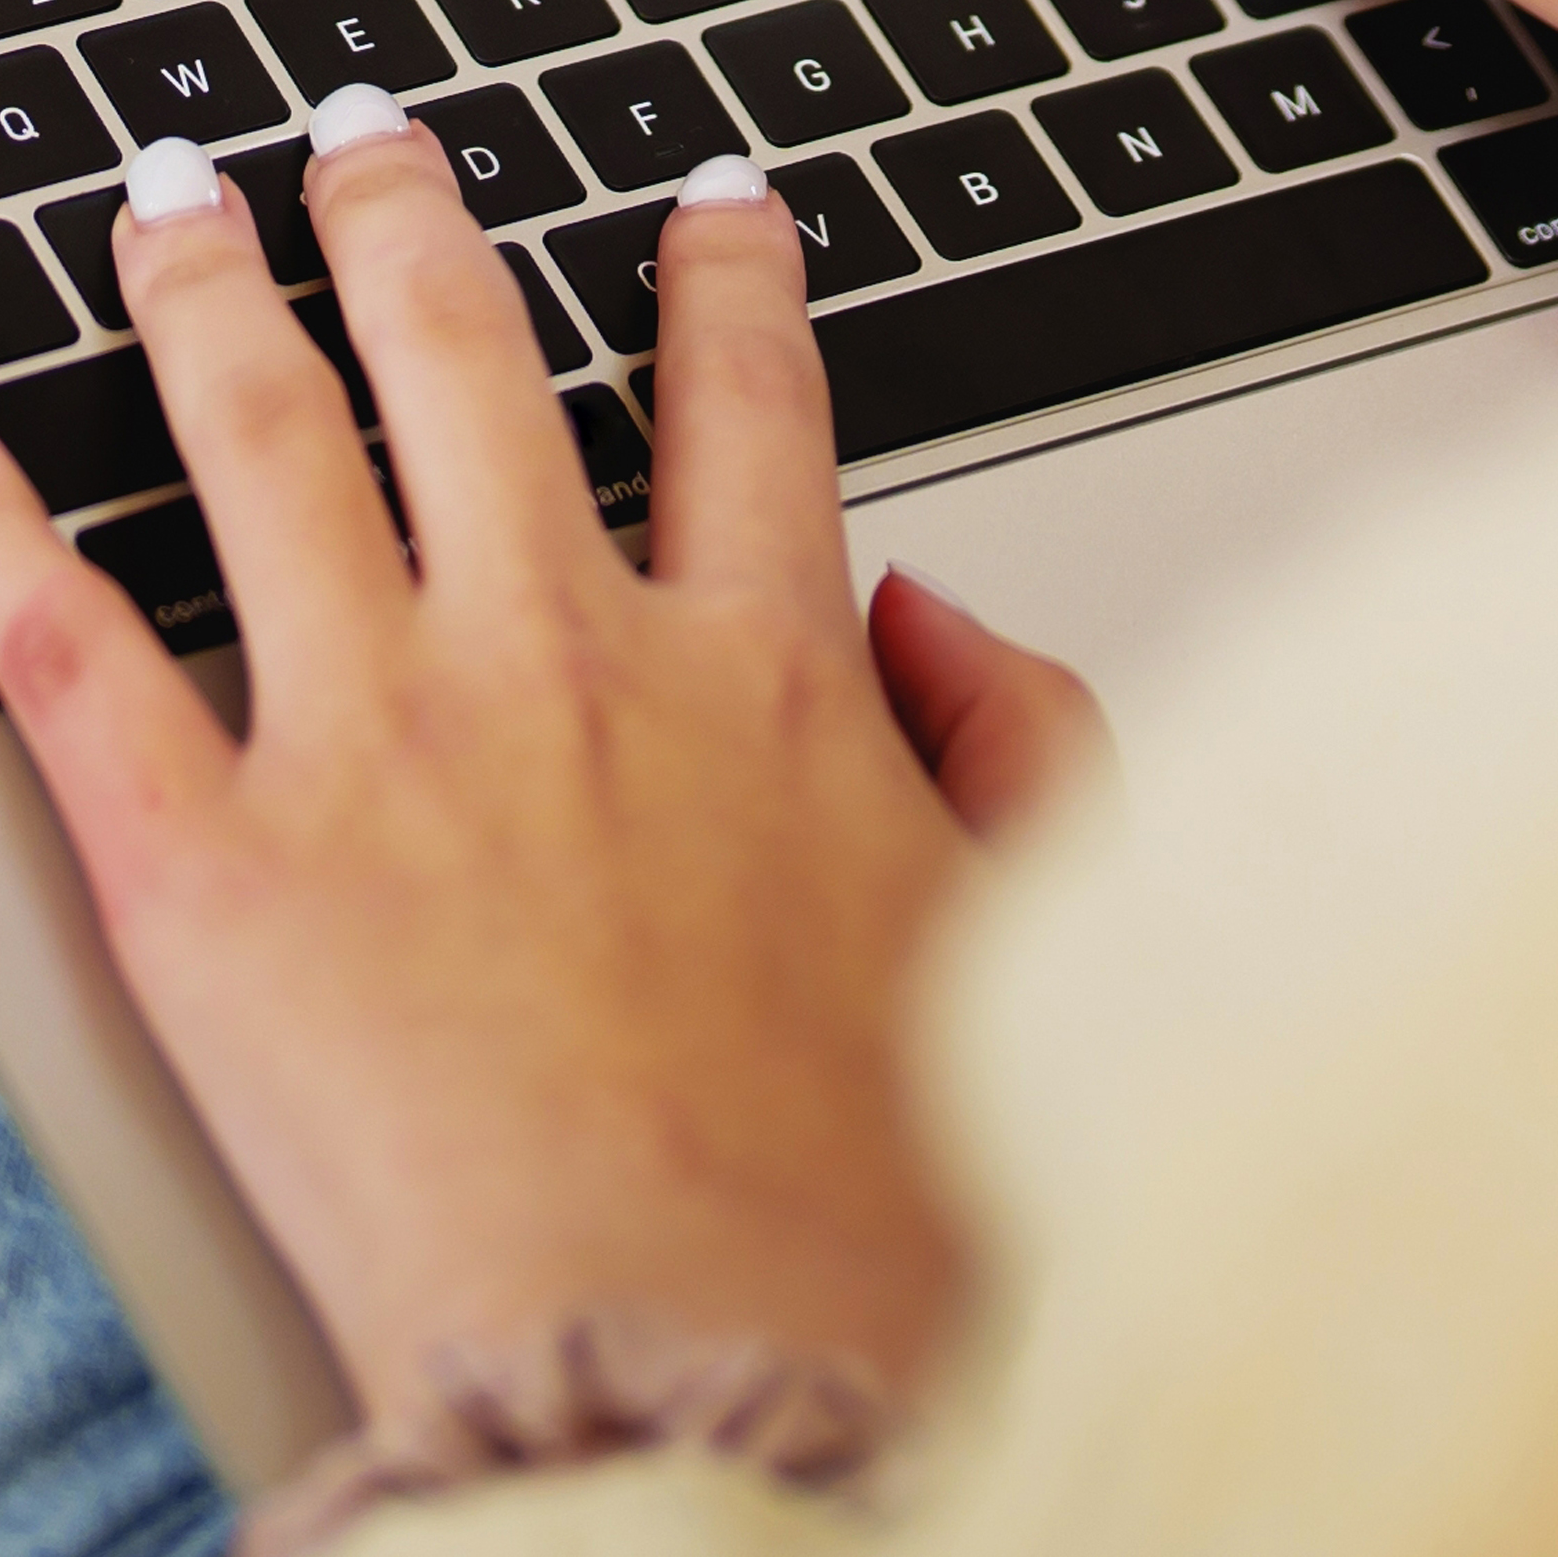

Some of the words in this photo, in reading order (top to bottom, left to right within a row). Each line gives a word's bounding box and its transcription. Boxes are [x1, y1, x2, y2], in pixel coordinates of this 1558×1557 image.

[336, 18, 374, 52] E
[951, 16, 995, 50] H
[161, 60, 209, 97] W
[794, 60, 830, 91] G
[630, 102, 657, 135] F
[1272, 86, 1320, 121] M
[0, 108, 39, 140] Q
[1118, 128, 1162, 162] N
[461, 146, 500, 180] D
[960, 173, 998, 205] B
[793, 214, 830, 247] V
